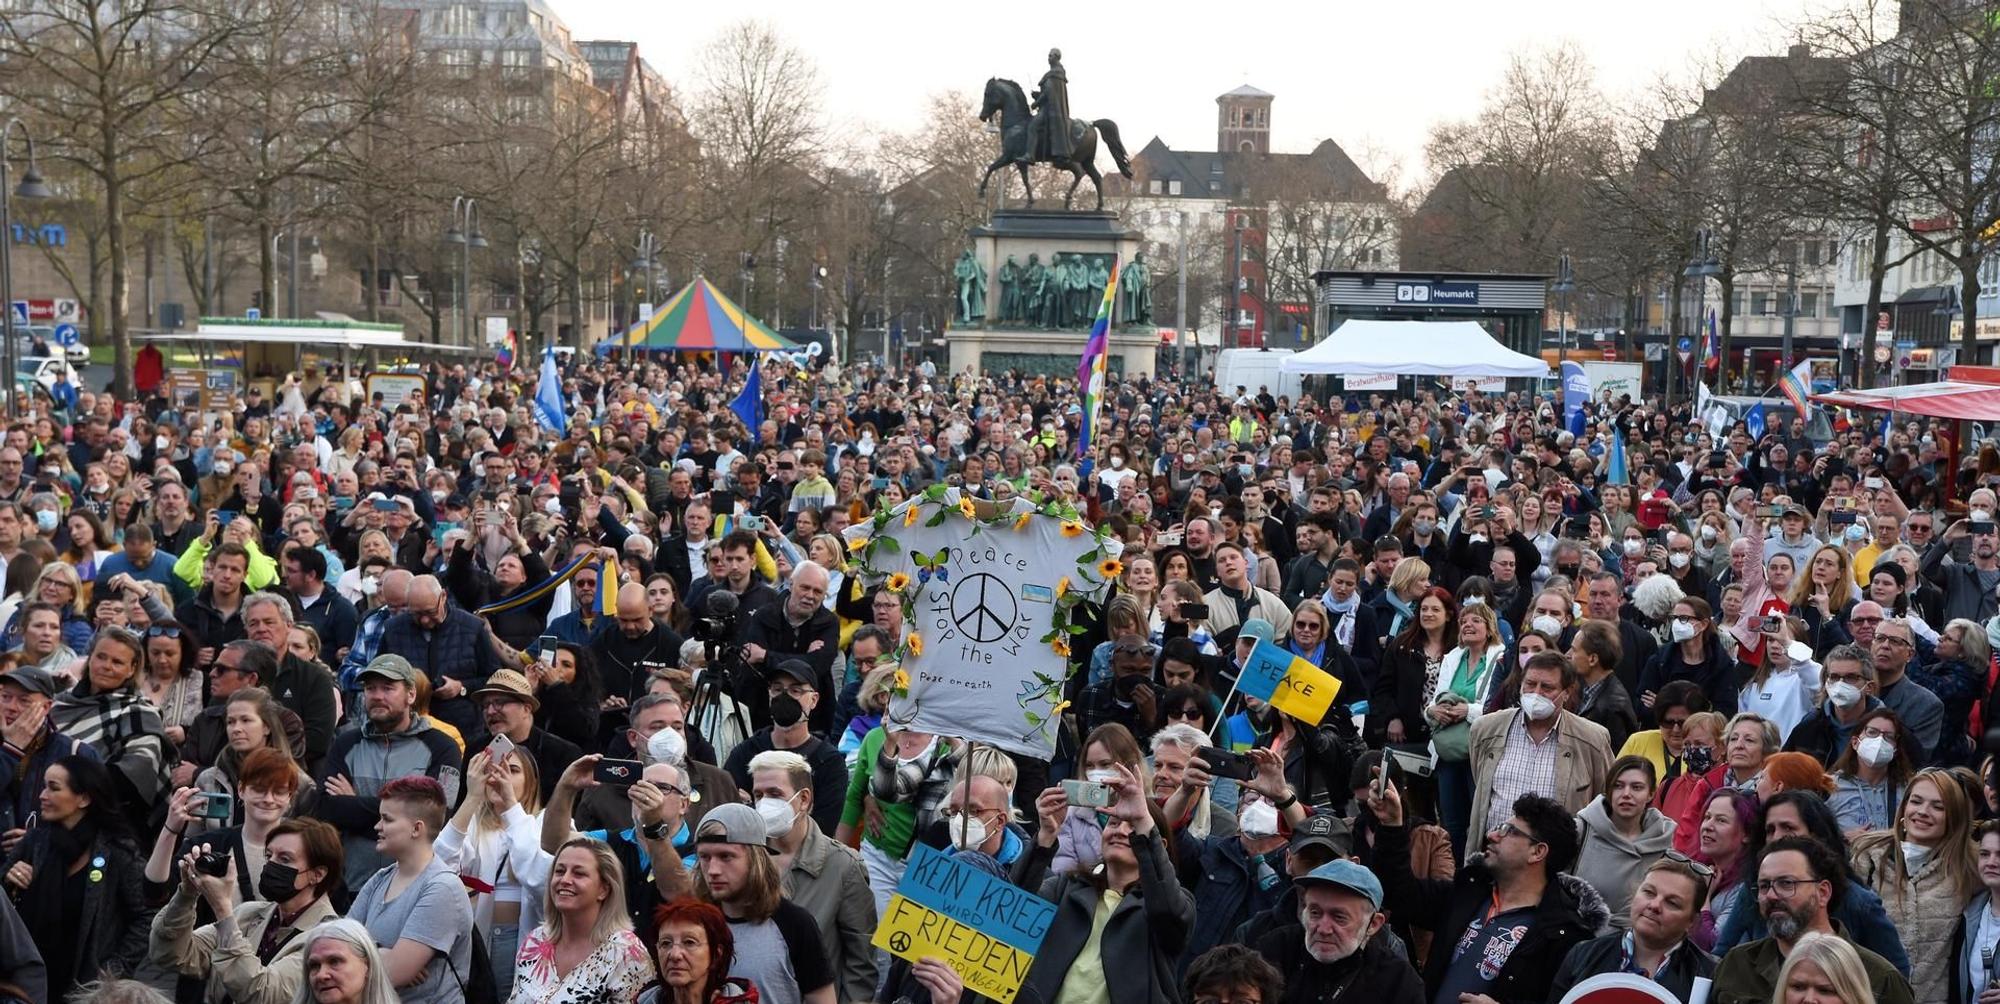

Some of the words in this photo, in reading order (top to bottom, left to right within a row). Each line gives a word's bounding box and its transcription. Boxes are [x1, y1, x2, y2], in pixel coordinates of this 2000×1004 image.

[1434, 289, 1474, 299] Heumarkt
[951, 546, 1027, 573] Peace
[929, 591, 955, 644] Stop
[961, 643, 993, 664] the
[1001, 612, 1033, 656] War
[964, 680, 992, 689] earth
[1260, 661, 1315, 697] PEACE
[912, 849, 971, 900] KEIN
[975, 879, 1056, 940] KRIEG
[941, 900, 984, 927] WIRD
[892, 897, 1033, 983] FRIEDEN
